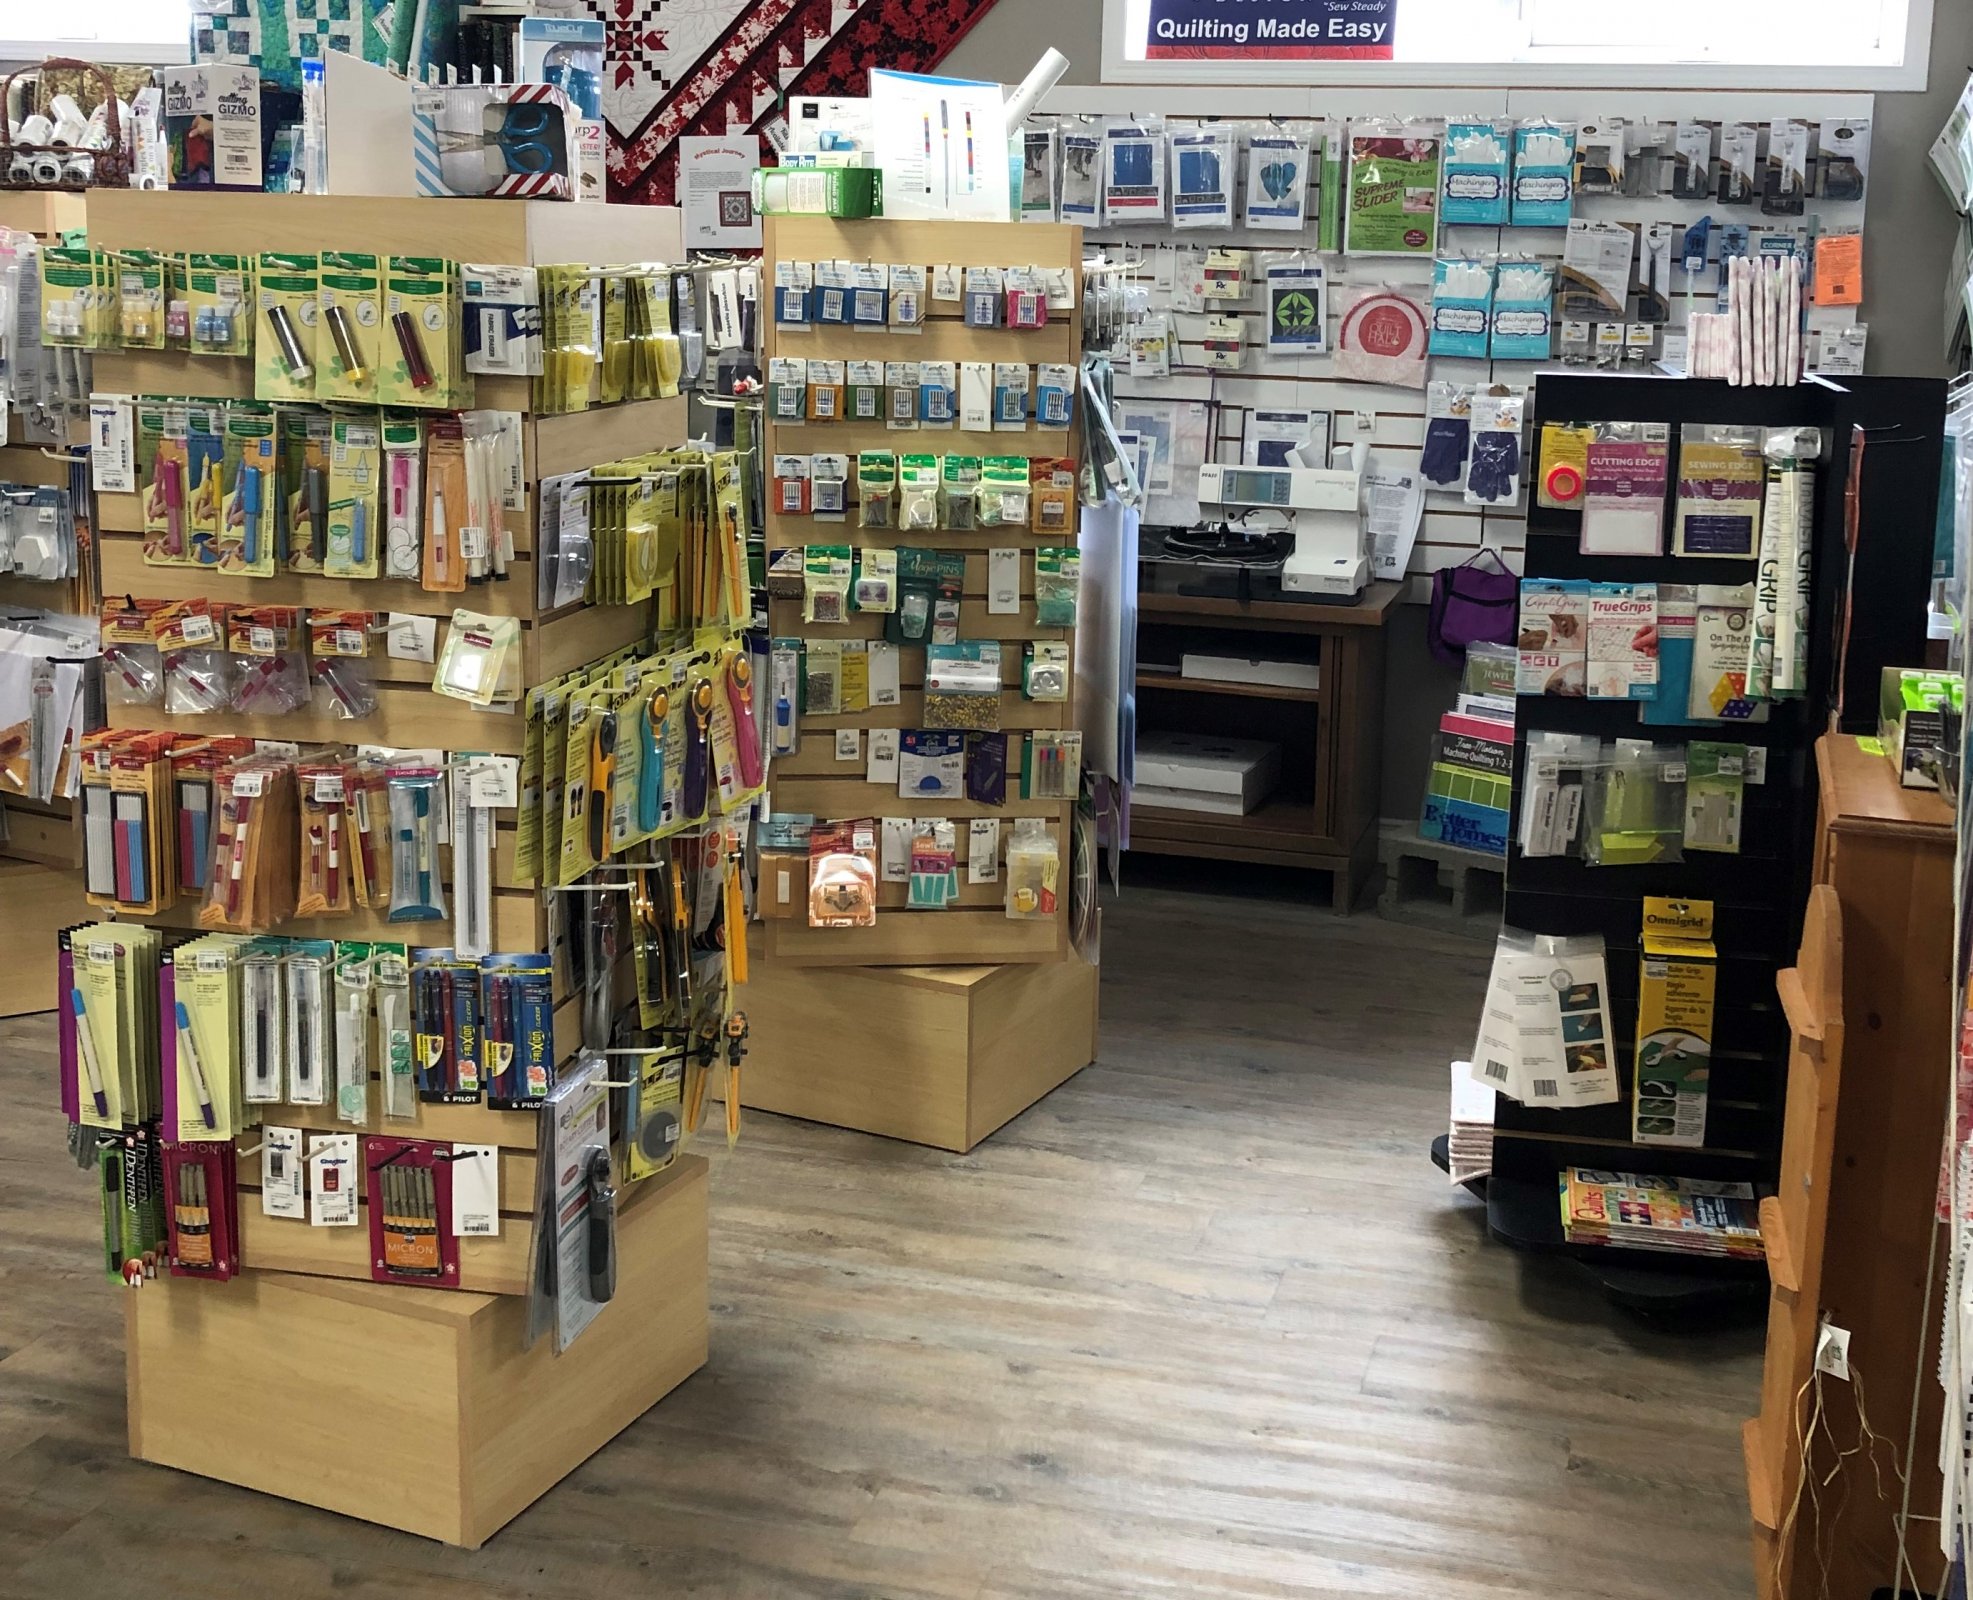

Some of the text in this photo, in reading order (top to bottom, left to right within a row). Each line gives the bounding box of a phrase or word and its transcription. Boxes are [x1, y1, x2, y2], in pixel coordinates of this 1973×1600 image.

[1327, 1, 1387, 13] Sew Steady
[1156, 18, 1387, 43] Quilting Made Easy
[168, 97, 192, 110] GIZMO
[218, 104, 256, 116] GIZMO
[694, 148, 746, 160] Mystical Journey
[780, 156, 815, 168] BODY RITE
[1354, 179, 1405, 199] SUPREME
[1353, 191, 1398, 212] SLIDER
[1439, 311, 1483, 322] Machingers
[488, 313, 496, 358] FABRIC ERASER
[1368, 324, 1402, 336] QUILT
[1590, 457, 1661, 467] CUTTING EDGE
[1688, 461, 1754, 470] SEWING EDGE
[1592, 601, 1652, 613] TrueGrips
[1726, 634, 1740, 642] The
[1443, 747, 1469, 761] Machine
[1469, 751, 1494, 767] Quilting
[1424, 804, 1481, 830] Better
[1442, 825, 1506, 849] Homes
[1646, 914, 1704, 928] Omnigrid
[368, 1142, 375, 1150] 6
[125, 1149, 137, 1213] IDENTIPEN
[1575, 1185, 1606, 1221] Quilts
[387, 1243, 434, 1255] MICRON
